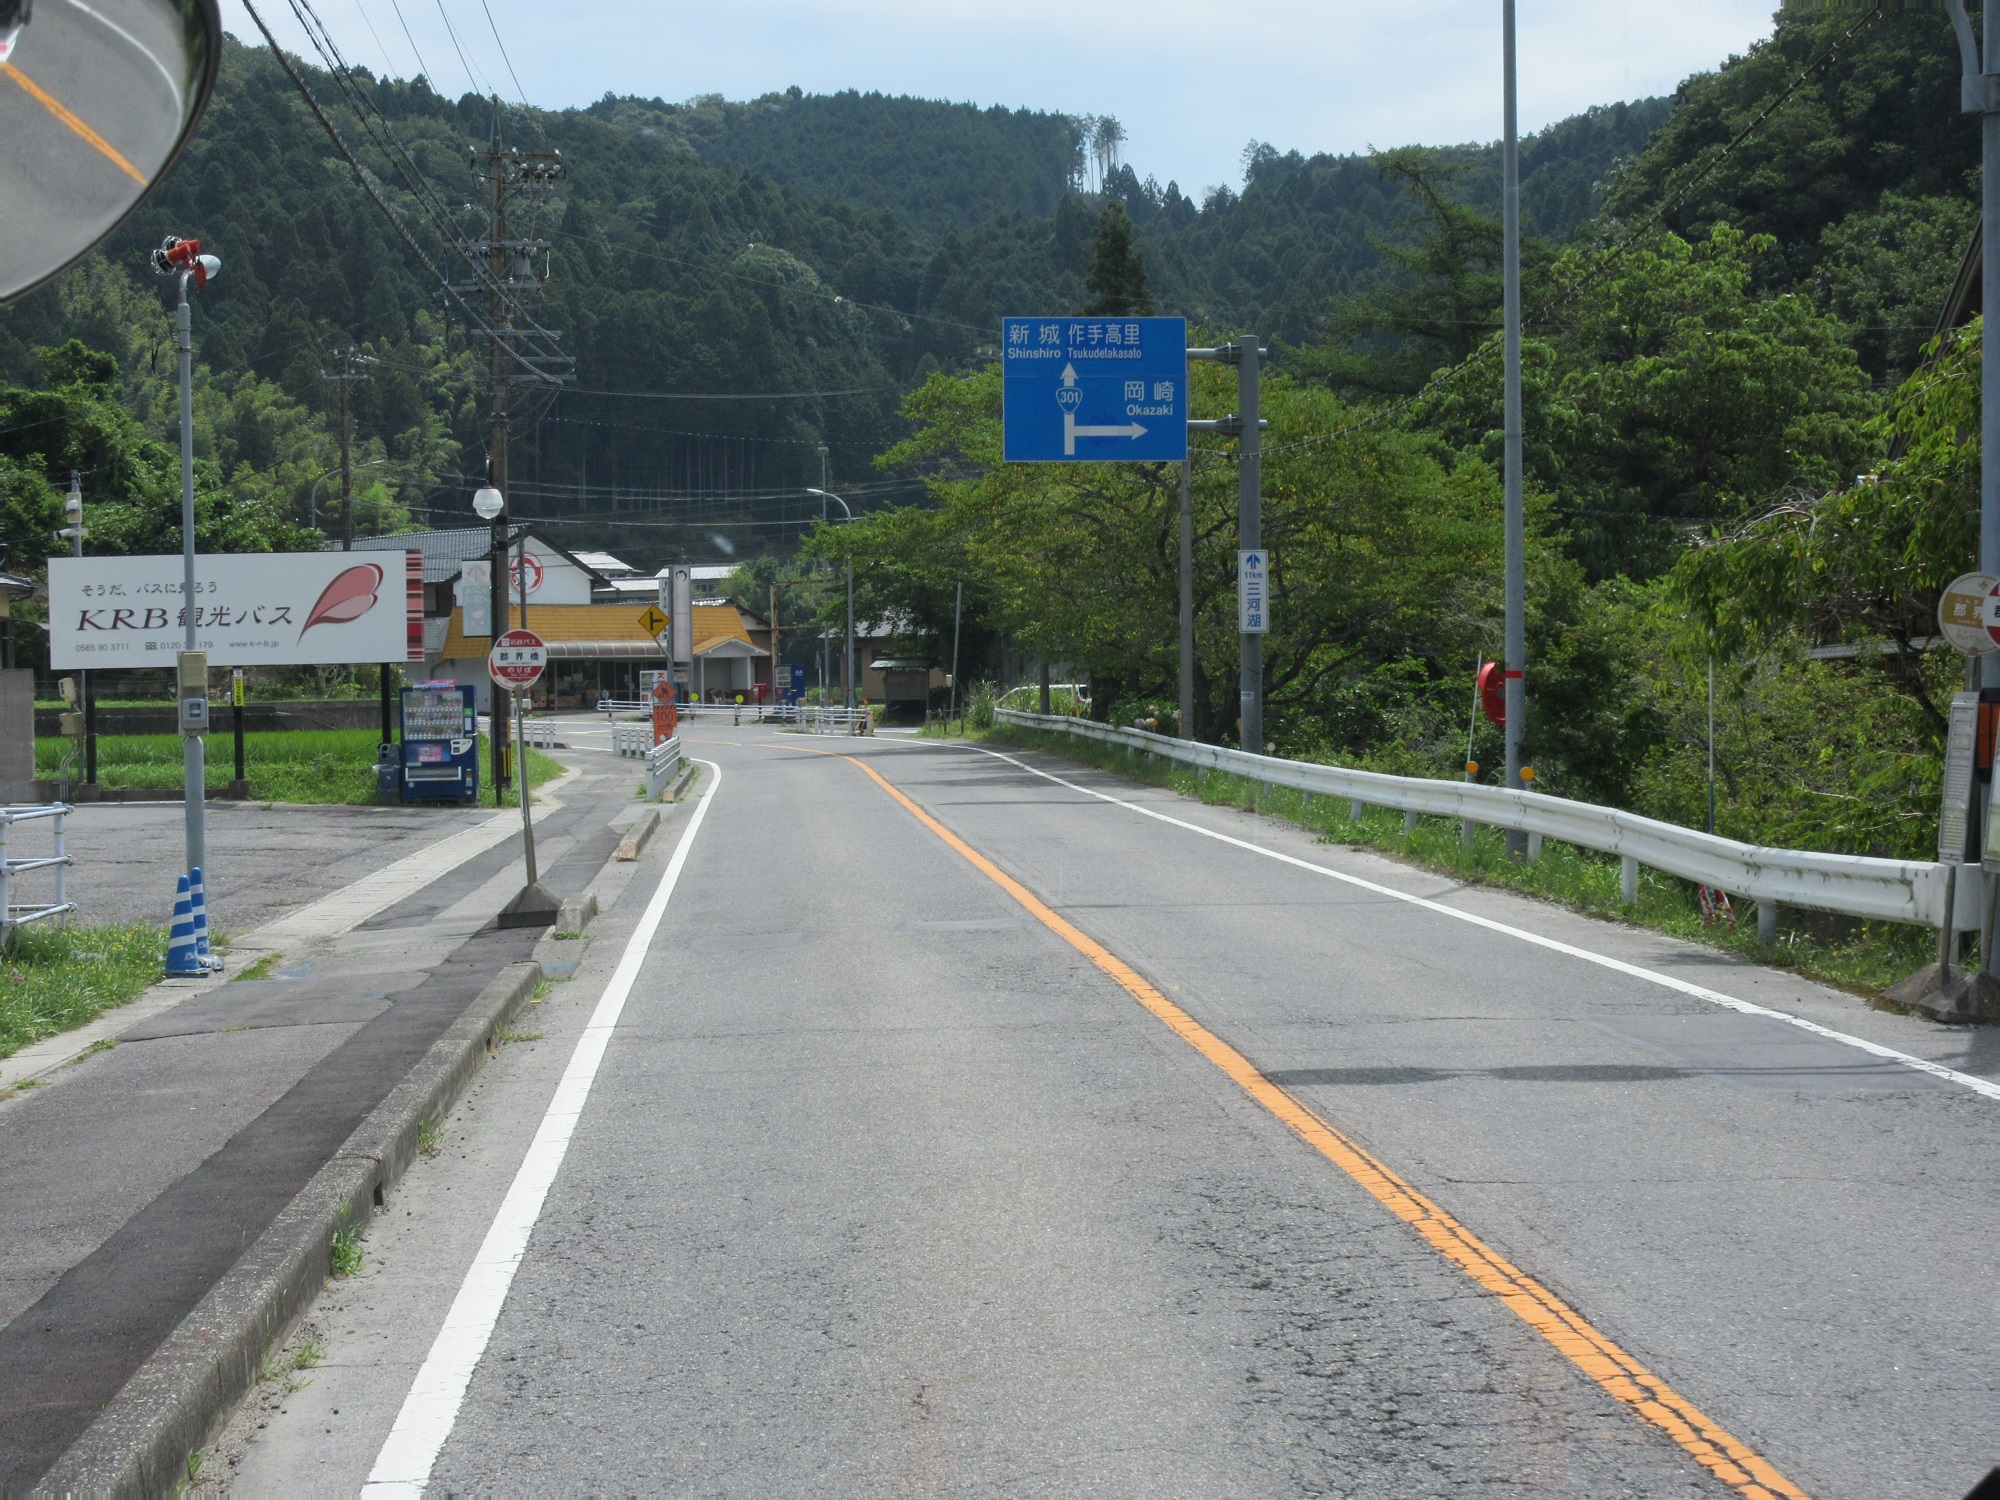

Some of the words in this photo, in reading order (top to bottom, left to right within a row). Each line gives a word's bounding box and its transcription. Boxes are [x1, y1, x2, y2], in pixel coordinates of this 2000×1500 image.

[1009, 324, 1060, 345] 新城
[1068, 323, 1141, 345] 作手高里
[1008, 347, 1061, 359] Shinshiro
[1067, 347, 1142, 359] Tsukudetakasato
[1060, 391, 1079, 404] 301
[1124, 380, 1175, 402] 岡崎
[1126, 404, 1174, 416] Okazaki
[1247, 583, 1261, 627] 三河湖
[75, 607, 169, 631] KRB
[656, 711, 674, 722] 100
